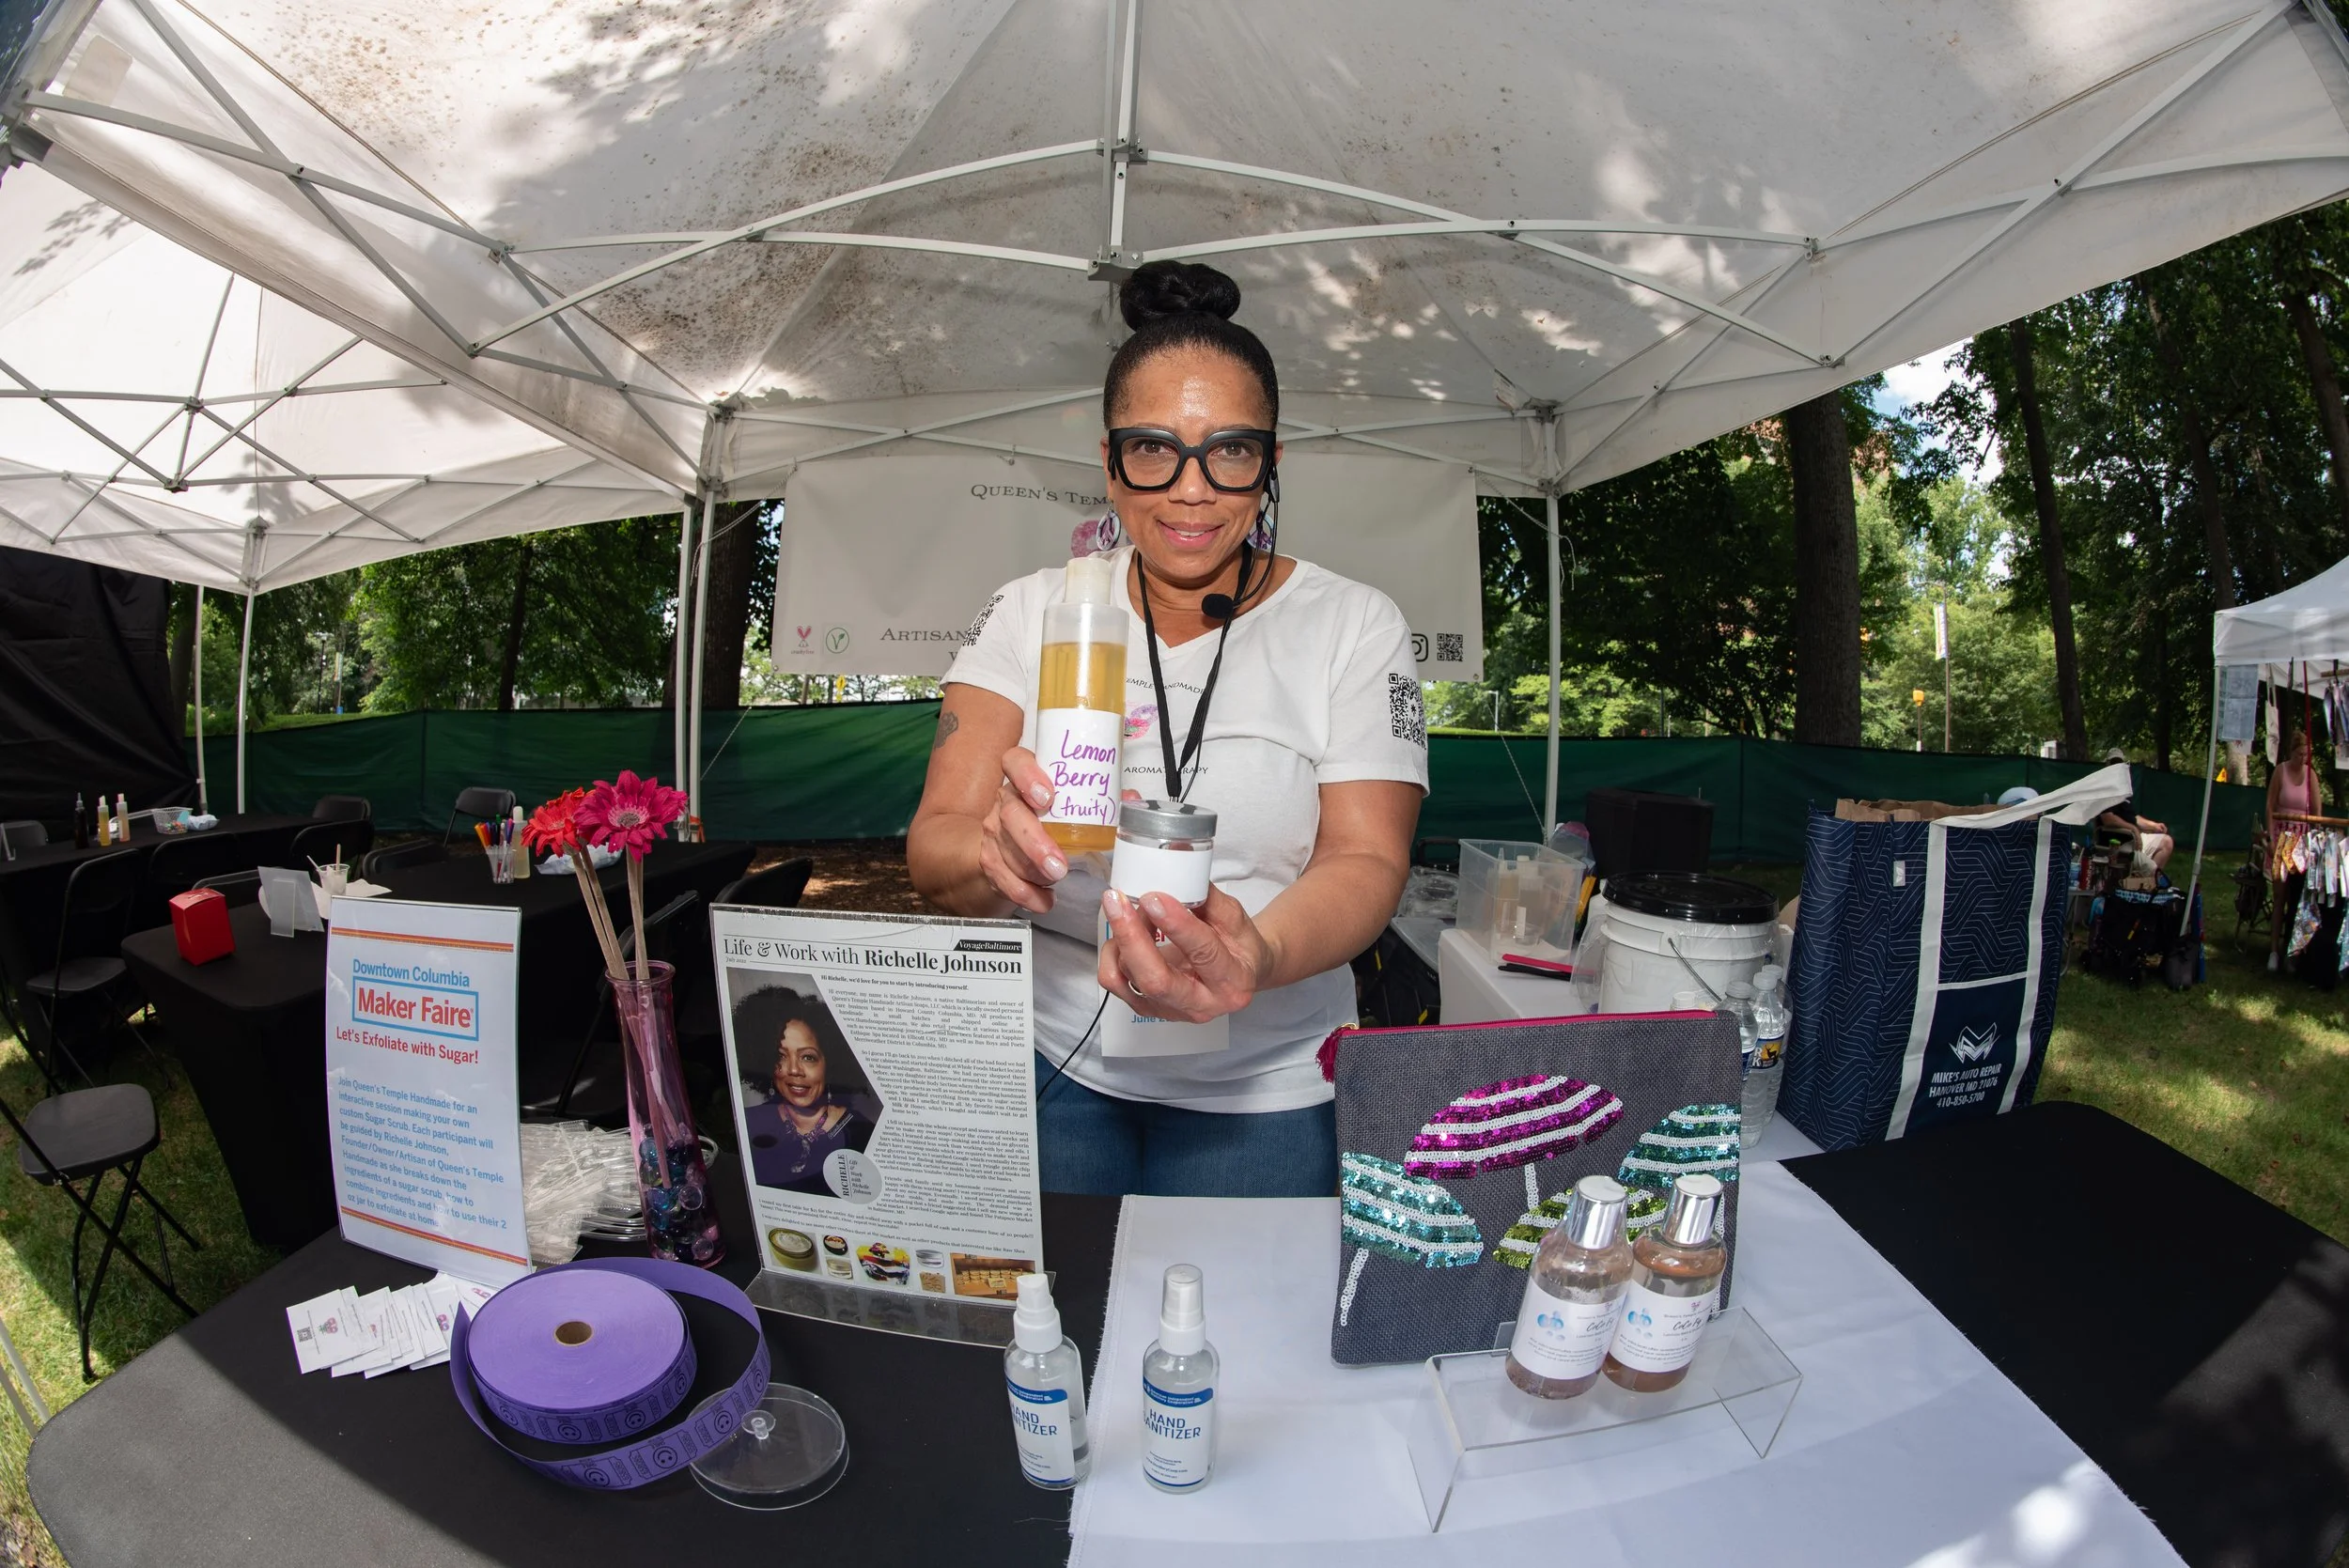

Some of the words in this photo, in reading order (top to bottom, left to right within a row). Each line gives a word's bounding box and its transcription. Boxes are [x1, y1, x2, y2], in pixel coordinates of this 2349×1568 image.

[971, 484, 1058, 502] QUEEN'S
[1065, 491, 1108, 505] TEM
[1127, 678, 1154, 690] EMPLE
[1061, 729, 1116, 765] Lemon
[1049, 761, 1110, 796] Berry
[1049, 790, 1116, 826] (fruity)
[723, 939, 752, 956] Life
[757, 941, 770, 957] &
[774, 943, 817, 961] Work
[821, 947, 859, 965] with
[864, 949, 938, 970] Richelle
[940, 955, 1022, 974] Johnson
[958, 940, 1021, 951] VoyageBaltimore
[353, 959, 409, 980] Downtown
[412, 966, 470, 986] Columbia
[358, 987, 416, 1019] Maker
[336, 1026, 360, 1043] Let's
[363, 1032, 408, 1051] Exfoliate
[412, 1042, 435, 1056] with
[439, 1045, 478, 1064] Sugar!
[1929, 1082, 1965, 1097] HANOVER
[1966, 1081, 1978, 1092] MD
[1979, 1078, 1998, 1090] 21076
[1932, 1072, 1960, 1083] MIKE'S
[1960, 1068, 1979, 1079] AUTO
[1980, 1063, 2002, 1078] REPAIR
[338, 1076, 350, 1087] Join
[353, 1079, 381, 1094] Queen's
[381, 1086, 408, 1101] Temple
[410, 1092, 450, 1109] Handmade
[453, 1101, 465, 1111] for
[467, 1106, 477, 1114] an
[338, 1091, 373, 1108] interactive
[375, 1102, 401, 1114] session
[404, 1109, 431, 1123] making
[432, 1114, 450, 1125] your
[453, 1119, 470, 1128] own
[1937, 1092, 1985, 1108] 410-850-5700
[339, 1108, 364, 1120] custom
[366, 1112, 385, 1126] Sugar
[387, 1118, 411, 1132] Scrub.
[412, 1124, 430, 1136] Each
[432, 1130, 476, 1145] participant
[479, 1138, 493, 1149] will
[340, 1120, 348, 1130] be
[350, 1125, 372, 1137] guided
[374, 1129, 382, 1141] by
[383, 1131, 412, 1147] Richelle
[414, 1140, 449, 1157] Johnson,
[343, 1150, 378, 1167] Handmade
[380, 1161, 387, 1170] as
[389, 1164, 402, 1174] she
[404, 1167, 428, 1181] breaks
[430, 1173, 451, 1187] down
[453, 1179, 467, 1190] the
[345, 1164, 381, 1182] ingredients
[383, 1176, 391, 1185] of
[398, 1181, 418, 1193] sugar
[446, 1192, 462, 1203] how
[465, 1197, 474, 1206] to
[428, 1158, 435, 1167] of
[438, 1160, 470, 1175] Queen's
[472, 1168, 504, 1183] Temple
[837, 1155, 849, 1196] RICHELLE
[346, 1180, 374, 1193] combine
[376, 1187, 415, 1206] ingredients
[418, 1201, 431, 1211] and
[433, 1203, 449, 1215] how
[451, 1208, 459, 1218] to
[462, 1213, 476, 1221] use
[478, 1215, 499, 1227] their
[501, 1219, 507, 1229] 2
[348, 1194, 355, 1203] oz
[357, 1196, 366, 1205] jar
[367, 1198, 375, 1208] to
[376, 1203, 407, 1217] exfoliate
[409, 1211, 416, 1220] at
[1012, 1404, 1038, 1424] AND
[1143, 1411, 1201, 1439] ANITIZER
[1150, 1408, 1186, 1428] HAND
